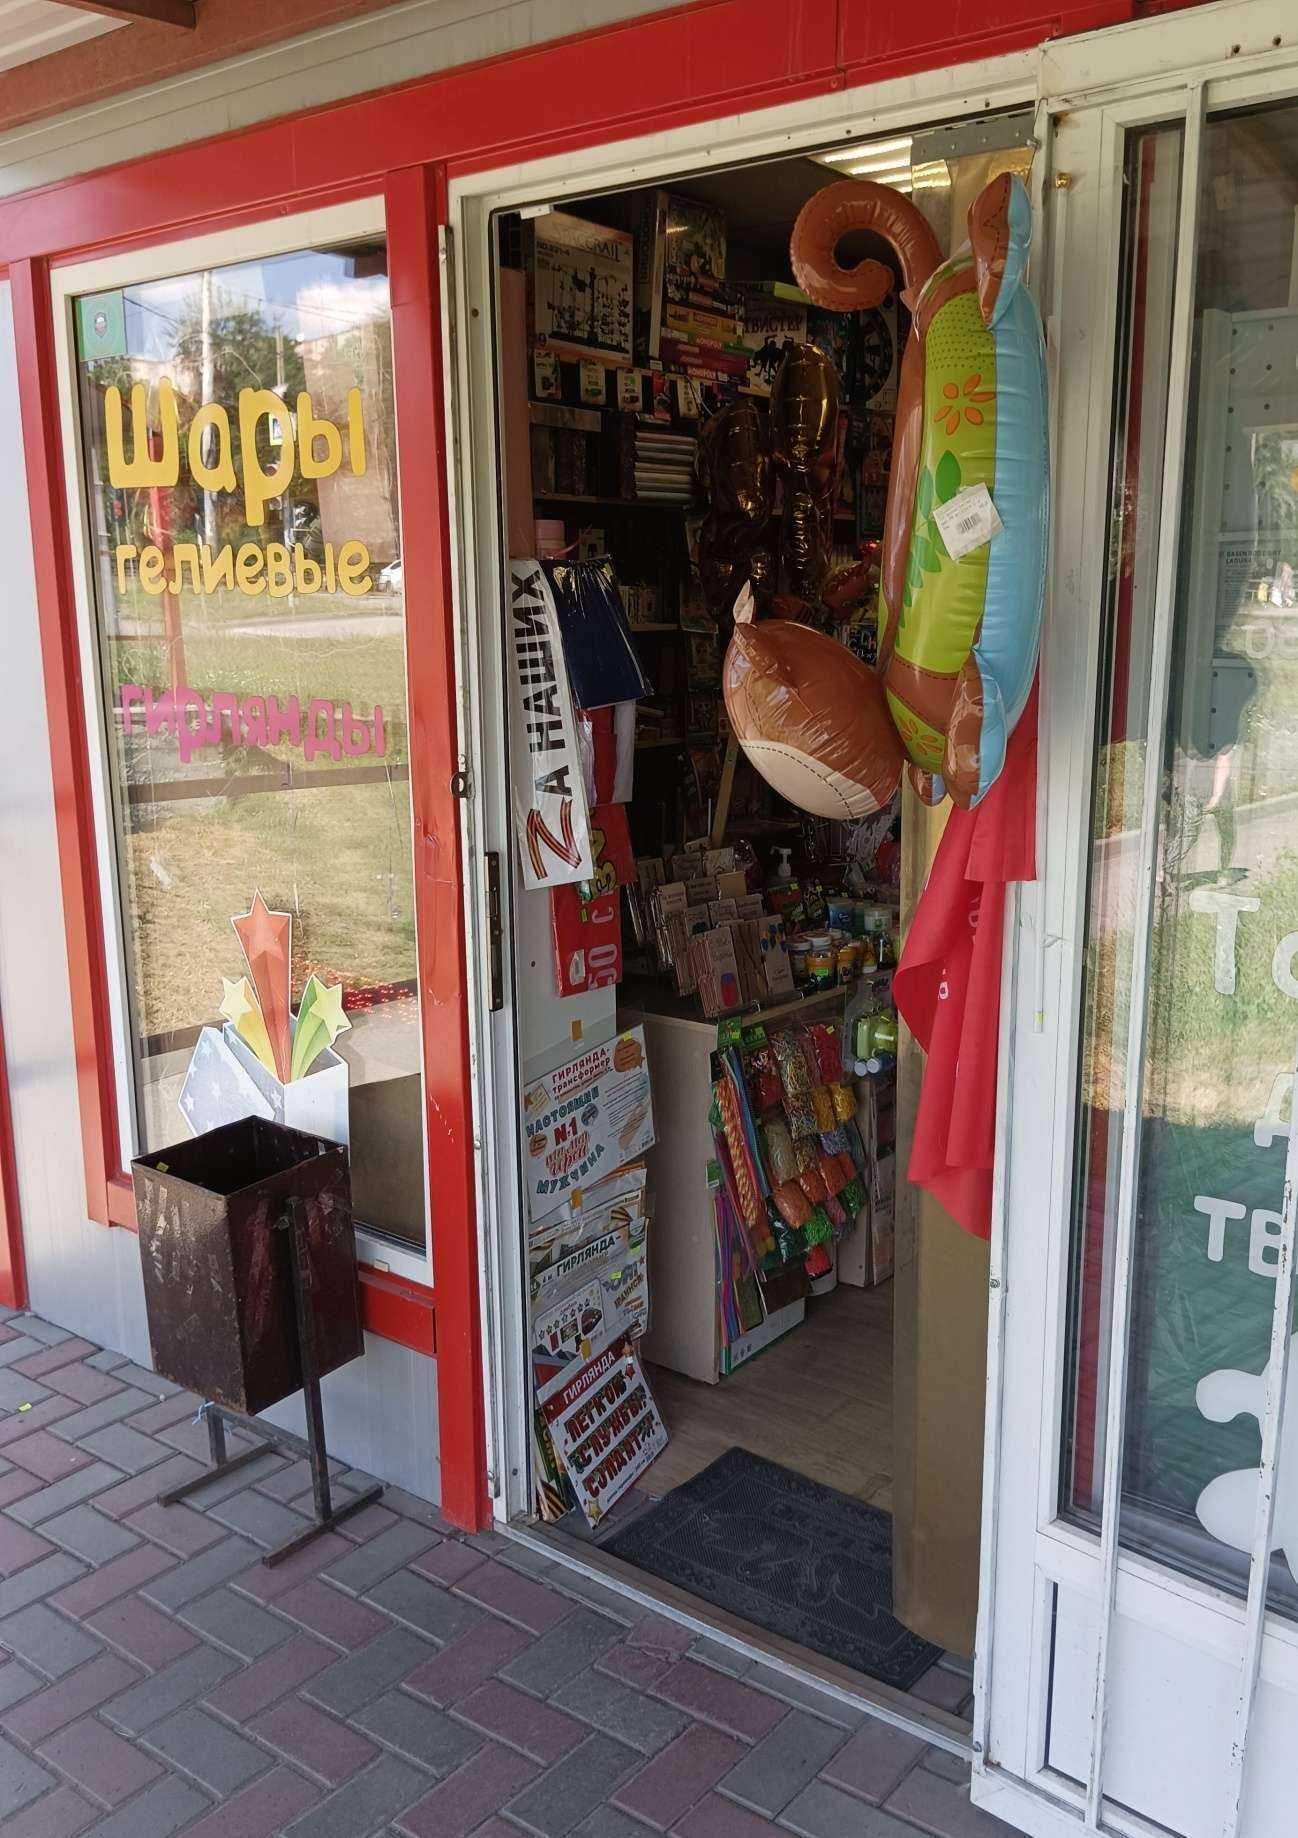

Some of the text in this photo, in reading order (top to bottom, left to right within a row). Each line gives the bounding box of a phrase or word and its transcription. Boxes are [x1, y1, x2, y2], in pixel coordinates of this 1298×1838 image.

[104, 376, 367, 527] Шары
[116, 539, 374, 598] гелиевые
[511, 569, 567, 754] НАШИХ
[121, 684, 387, 764] гирлянды
[536, 1143, 605, 1194] МУЖЧИНА
[562, 1351, 616, 1405] ГИРЛЯНДА
